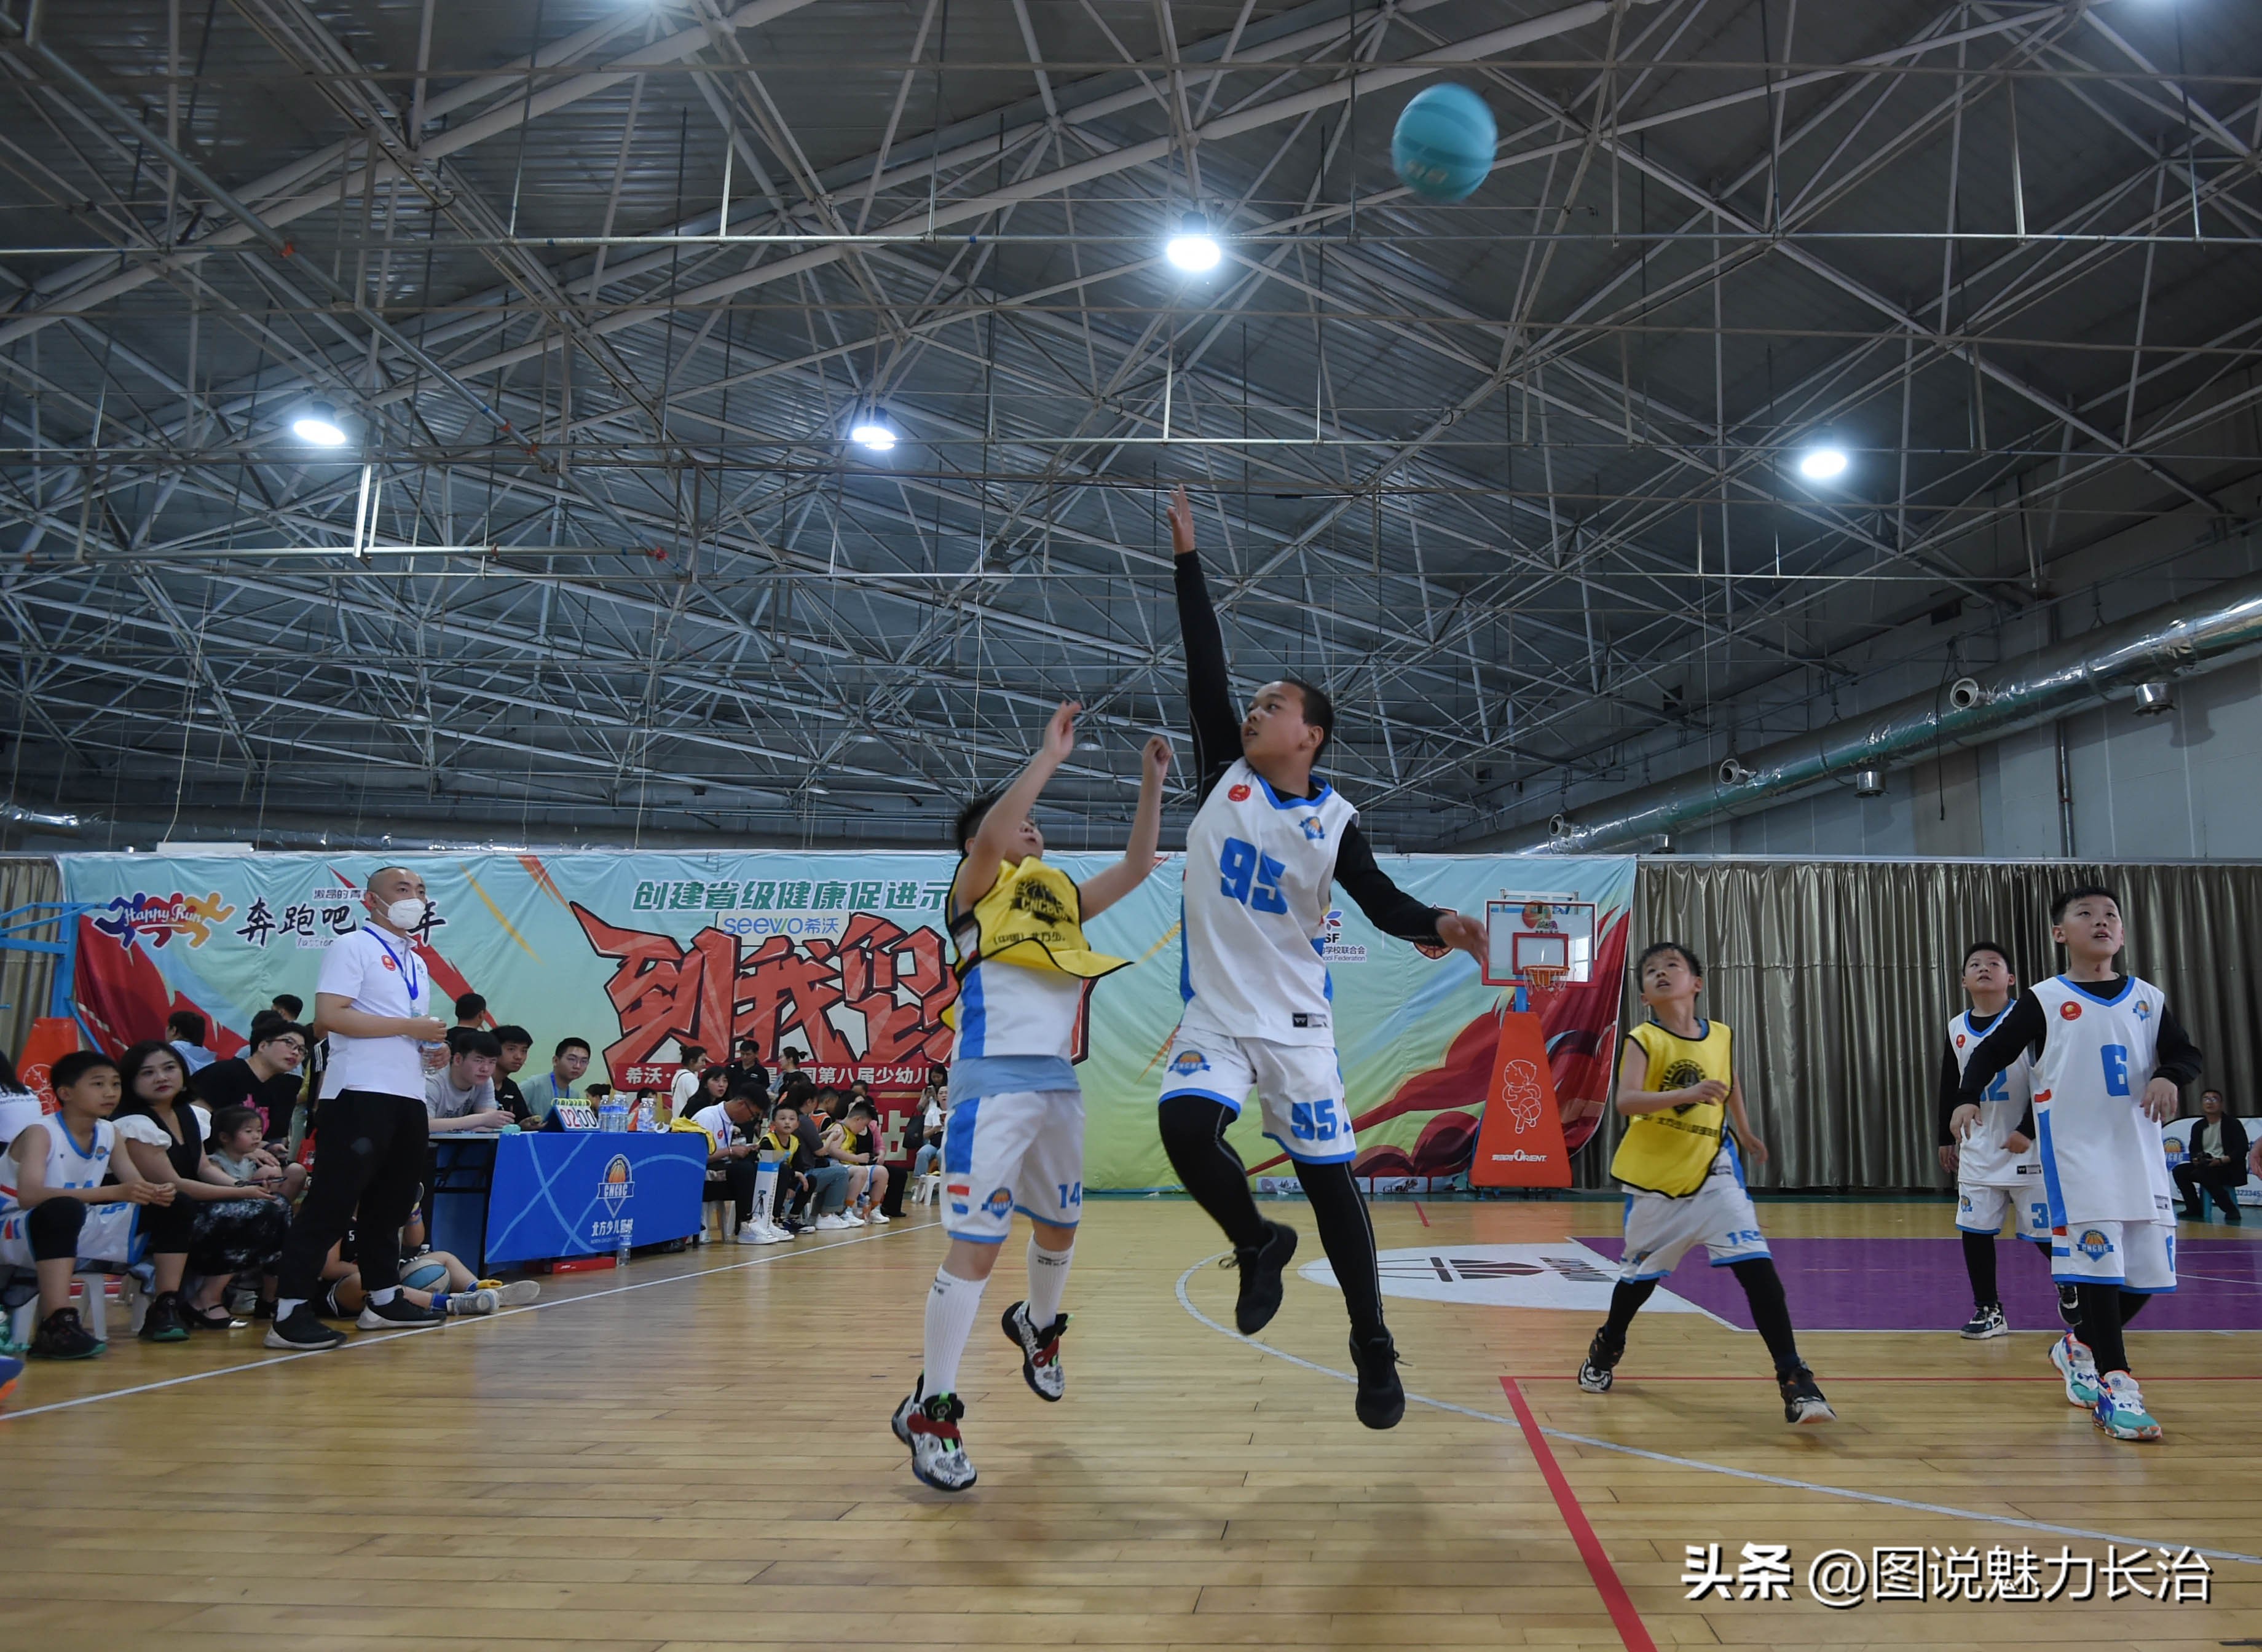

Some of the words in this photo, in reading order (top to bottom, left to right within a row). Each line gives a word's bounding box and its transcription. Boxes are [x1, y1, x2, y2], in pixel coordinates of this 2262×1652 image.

[1220, 836, 1288, 914] 95
[124, 907, 170, 927] Happy
[171, 904, 202, 922] Run
[236, 896, 447, 947] 奔跑吧年
[2100, 1044, 2130, 1097] 6
[560, 1108, 581, 1128] 02
[577, 1109, 597, 1128] 00
[1291, 1098, 1338, 1141] 95
[1514, 1149, 1547, 1162] ORIENT
[604, 1183, 629, 1197] CNCBC
[1058, 1181, 1082, 1209] 14
